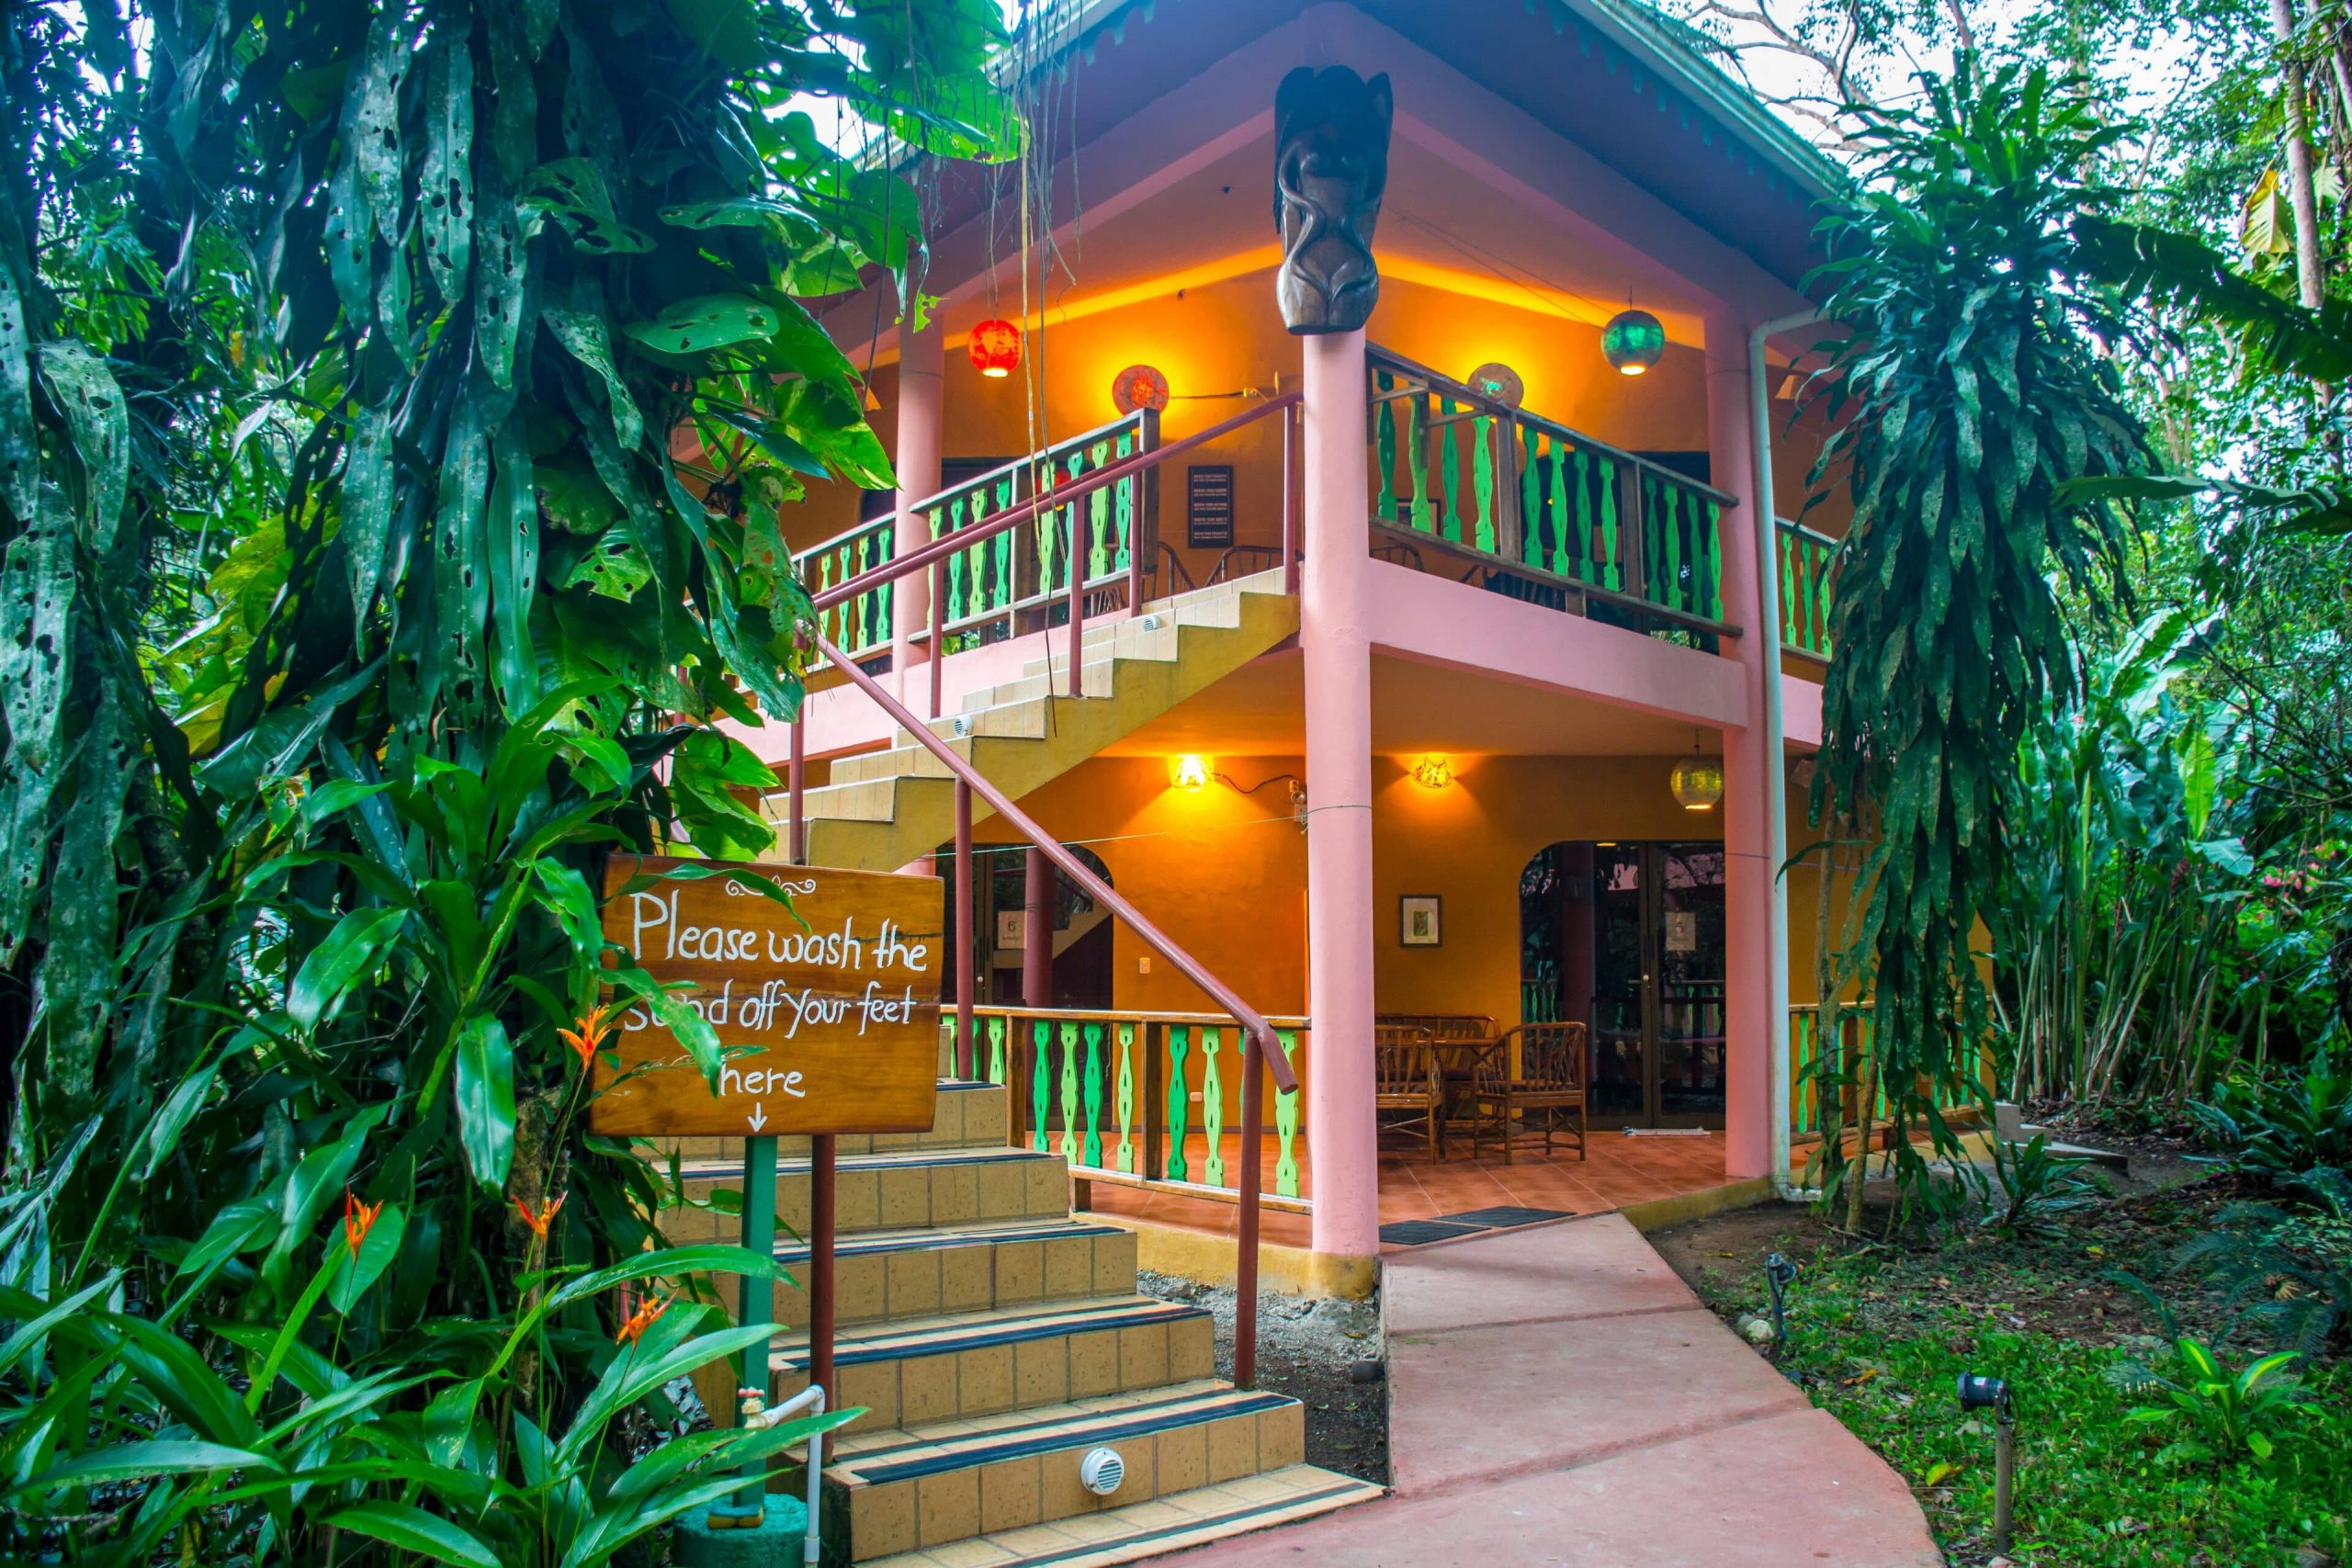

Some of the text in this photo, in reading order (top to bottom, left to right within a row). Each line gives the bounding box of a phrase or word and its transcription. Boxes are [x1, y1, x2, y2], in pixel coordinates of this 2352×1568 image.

[629, 889, 927, 971] Please wash the
[739, 979, 786, 1031] off
[857, 980, 917, 1036] feet
[720, 1056, 806, 1098] here
